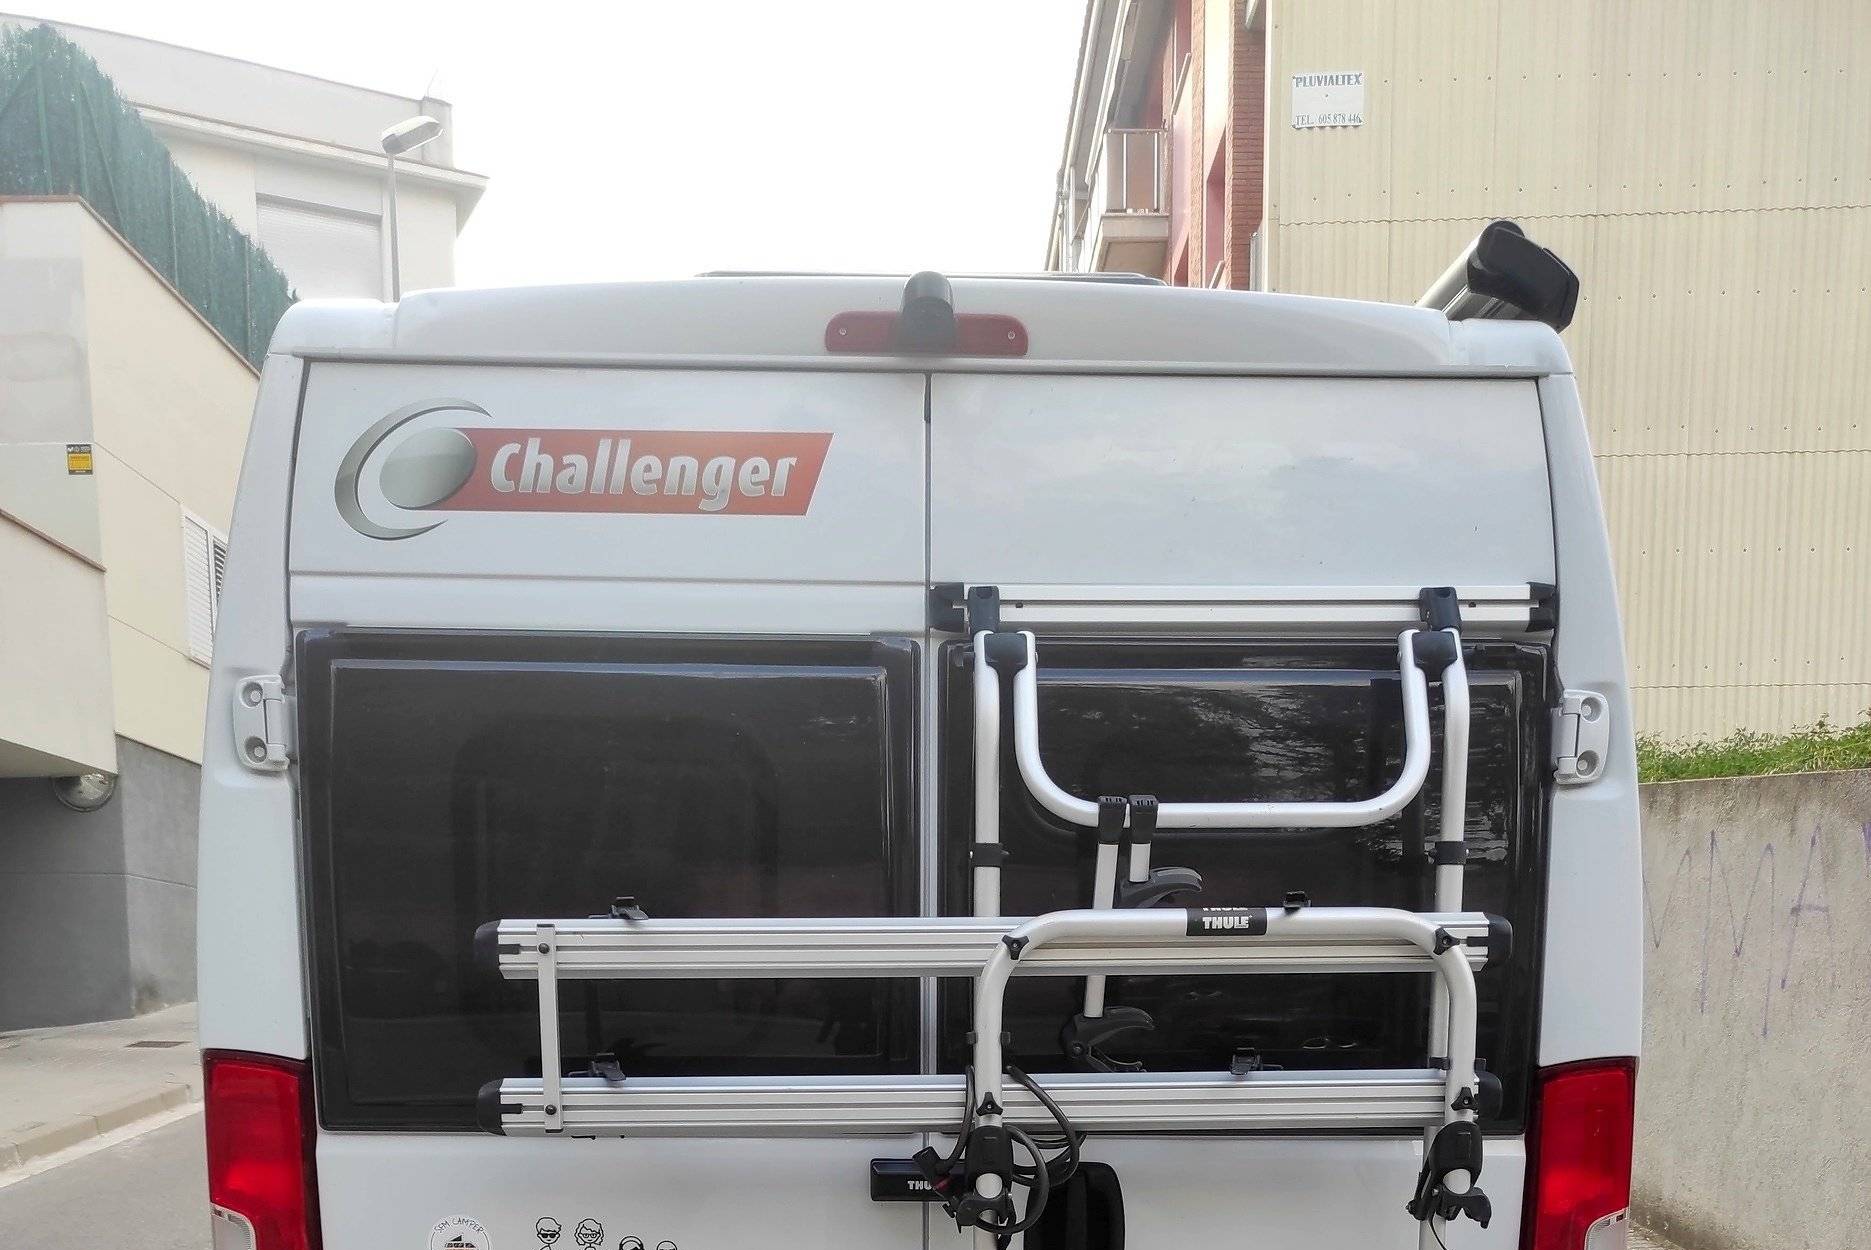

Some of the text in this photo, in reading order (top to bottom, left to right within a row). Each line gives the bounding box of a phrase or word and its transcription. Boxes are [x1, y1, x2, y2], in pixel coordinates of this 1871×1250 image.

[1295, 74, 1362, 88] PLUVIALTEX
[1296, 112, 1361, 125] TEL. 605 878 446
[490, 437, 798, 512] Challenger
[1202, 916, 1250, 930] THULE
[907, 1180, 932, 1190] THU
[451, 1217, 484, 1233] CAMPER
